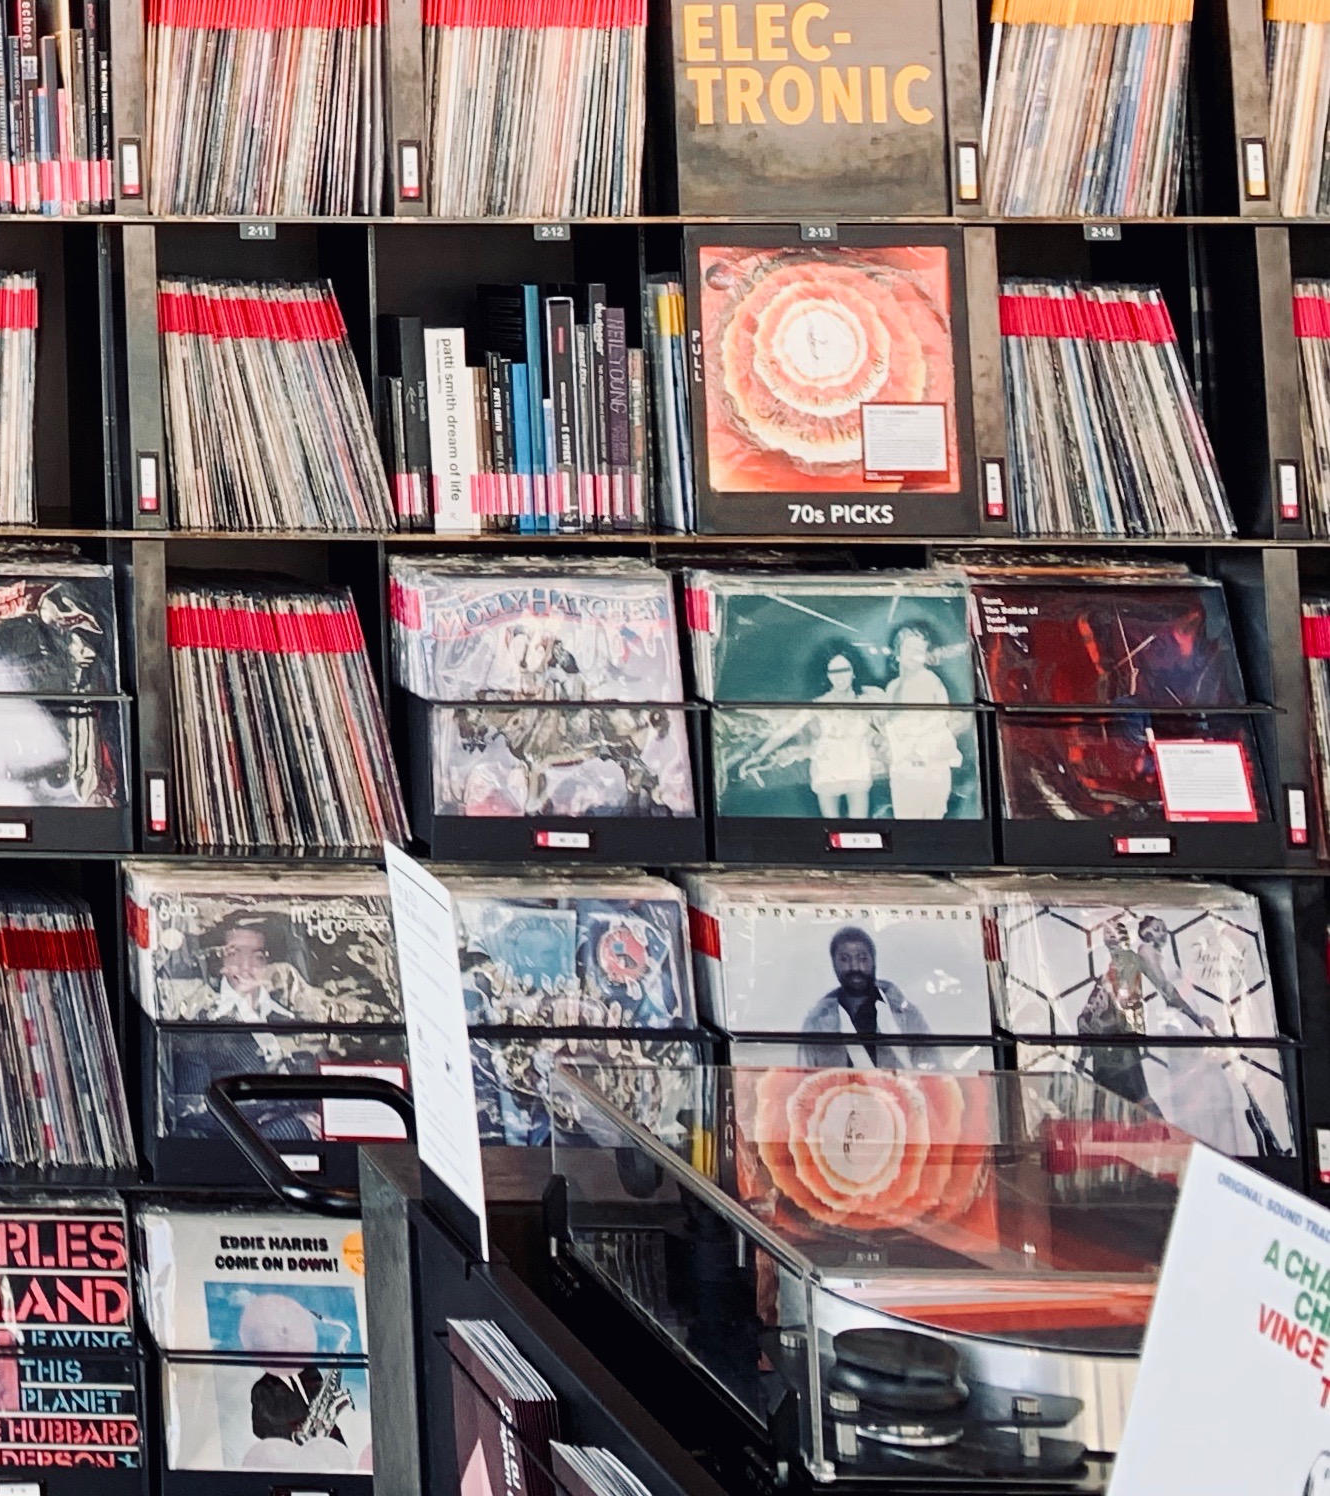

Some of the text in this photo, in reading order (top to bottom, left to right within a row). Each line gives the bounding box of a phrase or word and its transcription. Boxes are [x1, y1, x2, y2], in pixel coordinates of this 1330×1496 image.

[21, 1, 34, 49] echoes
[683, 2, 852, 62] ELEC-
[686, 65, 934, 125] TRONIC
[692, 330, 702, 382] PULL
[441, 338, 462, 501] patti smith dream of life
[493, 387, 503, 431] PATTI SMITH
[788, 504, 894, 524] 70s PICKS
[729, 907, 797, 921] TEDDY
[219, 1236, 329, 1251] EDDIE HARRIS
[214, 1255, 339, 1273] COME ON DOWN!
[1258, 1302, 1327, 1371] VINCE
[20, 1359, 83, 1384] THIS
[21, 1389, 123, 1413] PLANET
[8, 1418, 138, 1446] HUBBARD
